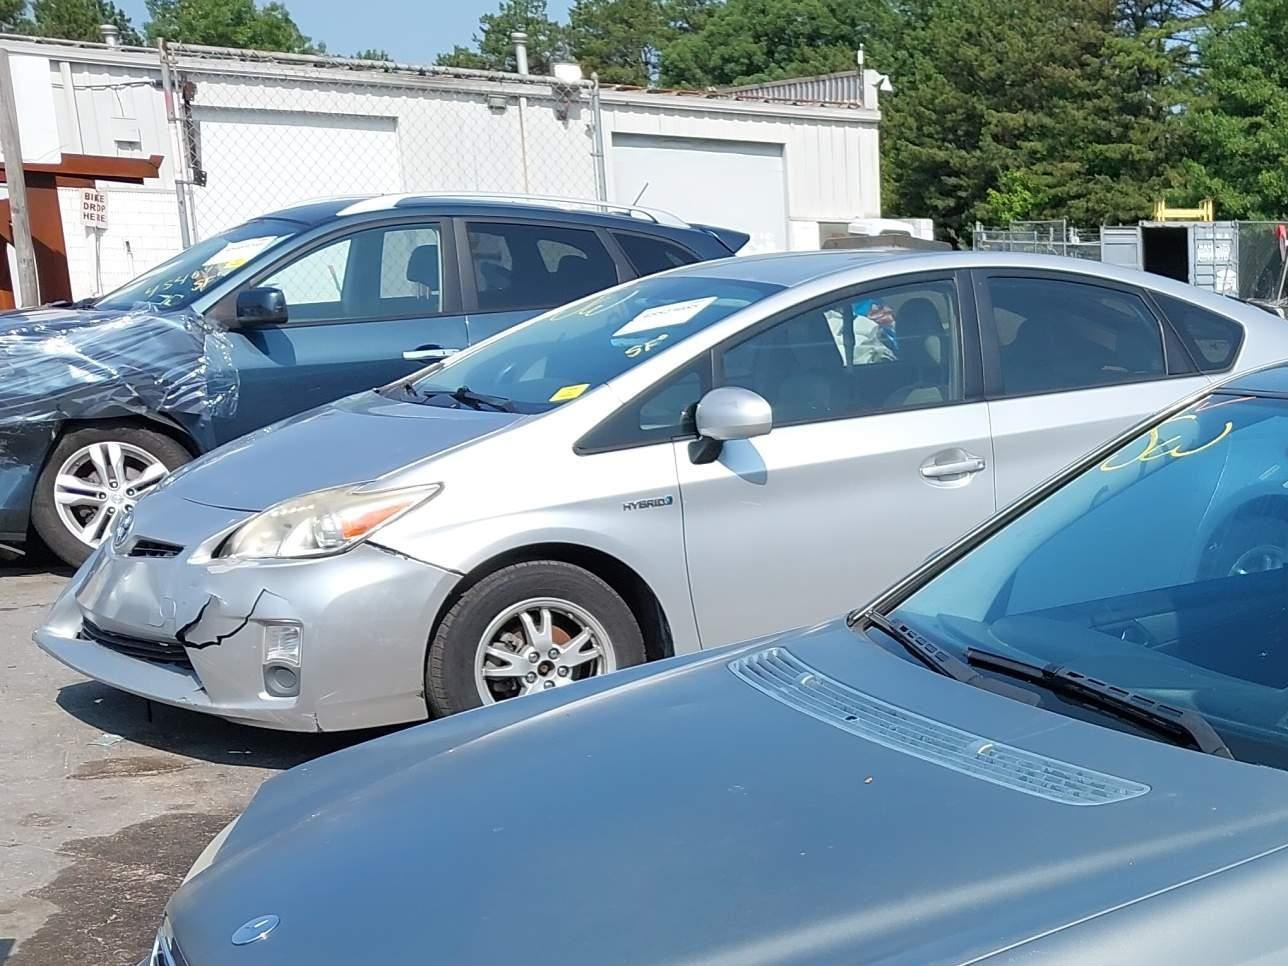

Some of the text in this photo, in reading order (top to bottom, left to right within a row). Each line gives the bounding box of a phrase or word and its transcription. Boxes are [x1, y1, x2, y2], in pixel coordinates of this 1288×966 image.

[84, 192, 105, 203] BIKE
[83, 202, 106, 212] DROP
[83, 212, 105, 222] HERE
[623, 498, 665, 511] HYBRID
